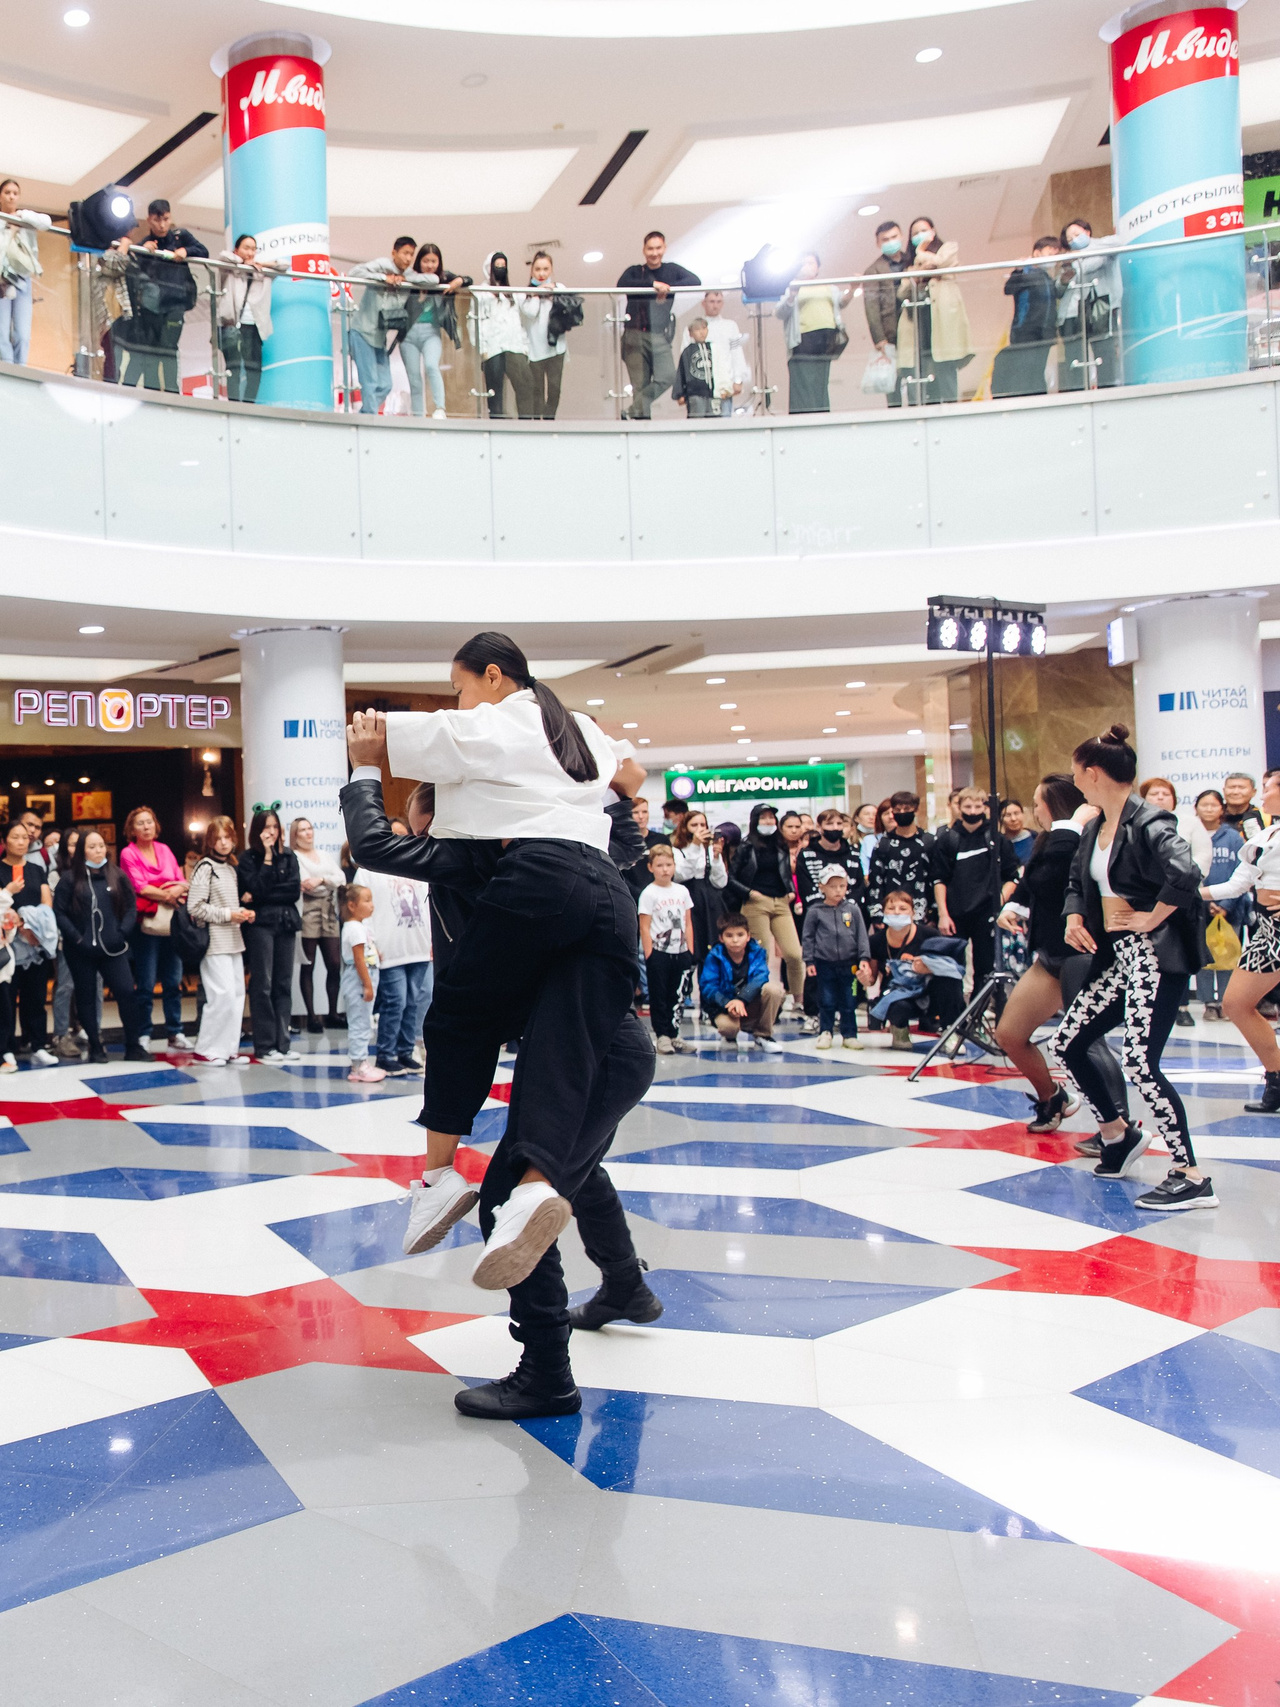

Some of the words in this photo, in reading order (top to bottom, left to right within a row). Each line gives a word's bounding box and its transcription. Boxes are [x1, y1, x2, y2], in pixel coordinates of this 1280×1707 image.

[1128, 210, 1153, 231] МЫ
[1201, 685, 1247, 699] ЧИТАЙ
[1201, 698, 1249, 709] ГОРОД
[1161, 747, 1251, 760] БЕСТСЕЛЛЕРЫ
